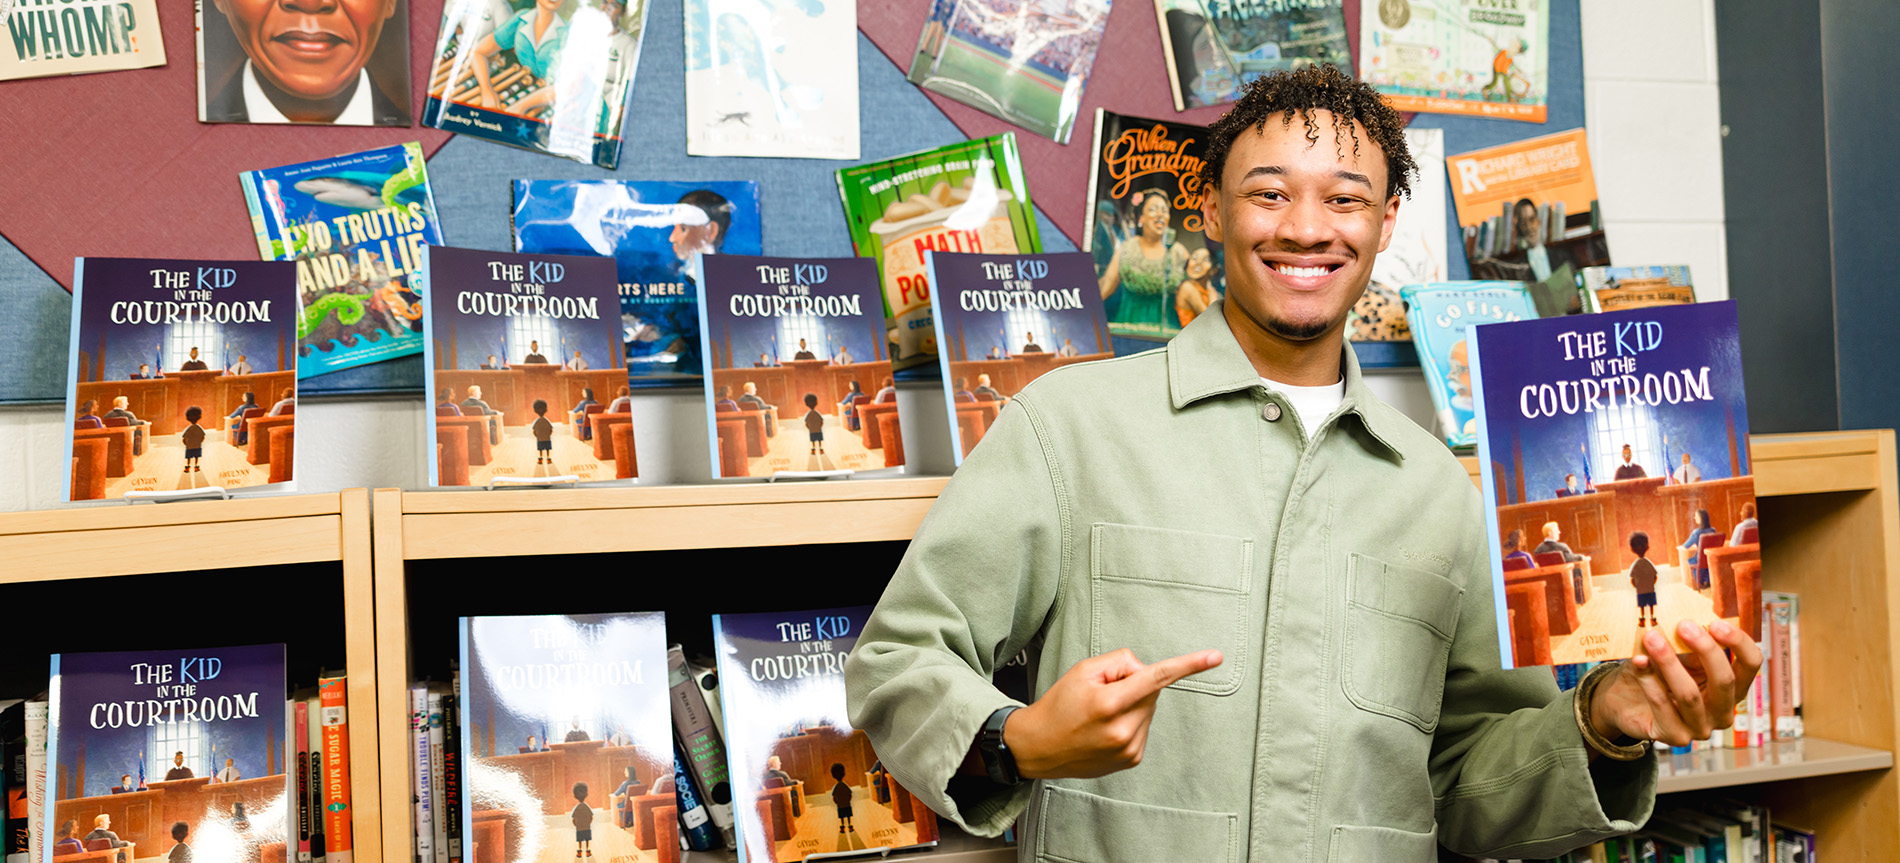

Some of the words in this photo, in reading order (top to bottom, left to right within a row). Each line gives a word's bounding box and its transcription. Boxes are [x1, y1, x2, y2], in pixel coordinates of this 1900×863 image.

[1121, 124, 1178, 153] When
[1455, 152, 1528, 195] RICHARD
[1526, 140, 1577, 161] WRIGHT
[1508, 165, 1549, 181] LIBRARY
[1550, 156, 1580, 172] CARD
[279, 220, 332, 256] TWO
[332, 202, 426, 246] TRUTHS
[914, 228, 983, 266] MATH
[297, 253, 351, 294] AND
[357, 248, 378, 282] A
[380, 232, 424, 278] LIE
[488, 261, 524, 282] THE
[528, 260, 566, 284] KID
[756, 264, 790, 285] THE
[794, 263, 828, 286] KID
[981, 262, 1014, 280] THE
[1016, 258, 1049, 281] KID
[150, 268, 190, 289] THE
[196, 266, 236, 290] KID
[511, 282, 522, 294] IN
[523, 282, 545, 296] THE
[649, 282, 684, 296] HERE
[778, 284, 789, 296] IN
[790, 284, 811, 296] THE
[1003, 280, 1014, 290] IN
[1014, 280, 1033, 290] THE
[174, 289, 186, 301] IN
[189, 290, 212, 302] THE
[457, 290, 600, 320] COURTROOM
[730, 294, 863, 318] COURTROOM
[960, 288, 1084, 312] COURTROOM
[110, 300, 272, 324] COURTROOM
[1436, 304, 1462, 328] GO
[1557, 330, 1607, 361] THE
[1614, 321, 1663, 357] KID
[1590, 359, 1606, 376] IN
[1607, 356, 1636, 376] THE
[1520, 366, 1714, 419] COURTROOM
[530, 627, 568, 649] THE
[572, 623, 608, 648] KID
[776, 621, 812, 643] THE
[816, 616, 850, 640] KID
[1579, 634, 1610, 646] CAYDEN
[800, 641, 811, 653] IN
[812, 640, 833, 653] THE
[1584, 646, 1608, 658] BROWN
[130, 662, 173, 686] THE
[180, 657, 222, 684] KID
[496, 659, 644, 692] COURTROOM
[751, 651, 849, 682] COURTRO
[156, 684, 171, 698] IN
[172, 683, 196, 697] THE
[90, 692, 260, 730] COURTROOM
[328, 734, 340, 766] SUGAR
[419, 736, 428, 766] TROUBLE
[694, 749, 720, 763] ORDER
[28, 762, 47, 807] Wishing
[330, 768, 342, 800] MAGIC
[420, 769, 430, 790] FINDS
[445, 752, 458, 806] WILDFIRE
[420, 791, 430, 812] PLUM!
[676, 775, 697, 810] SOCIE
[16, 828, 28, 846] The
